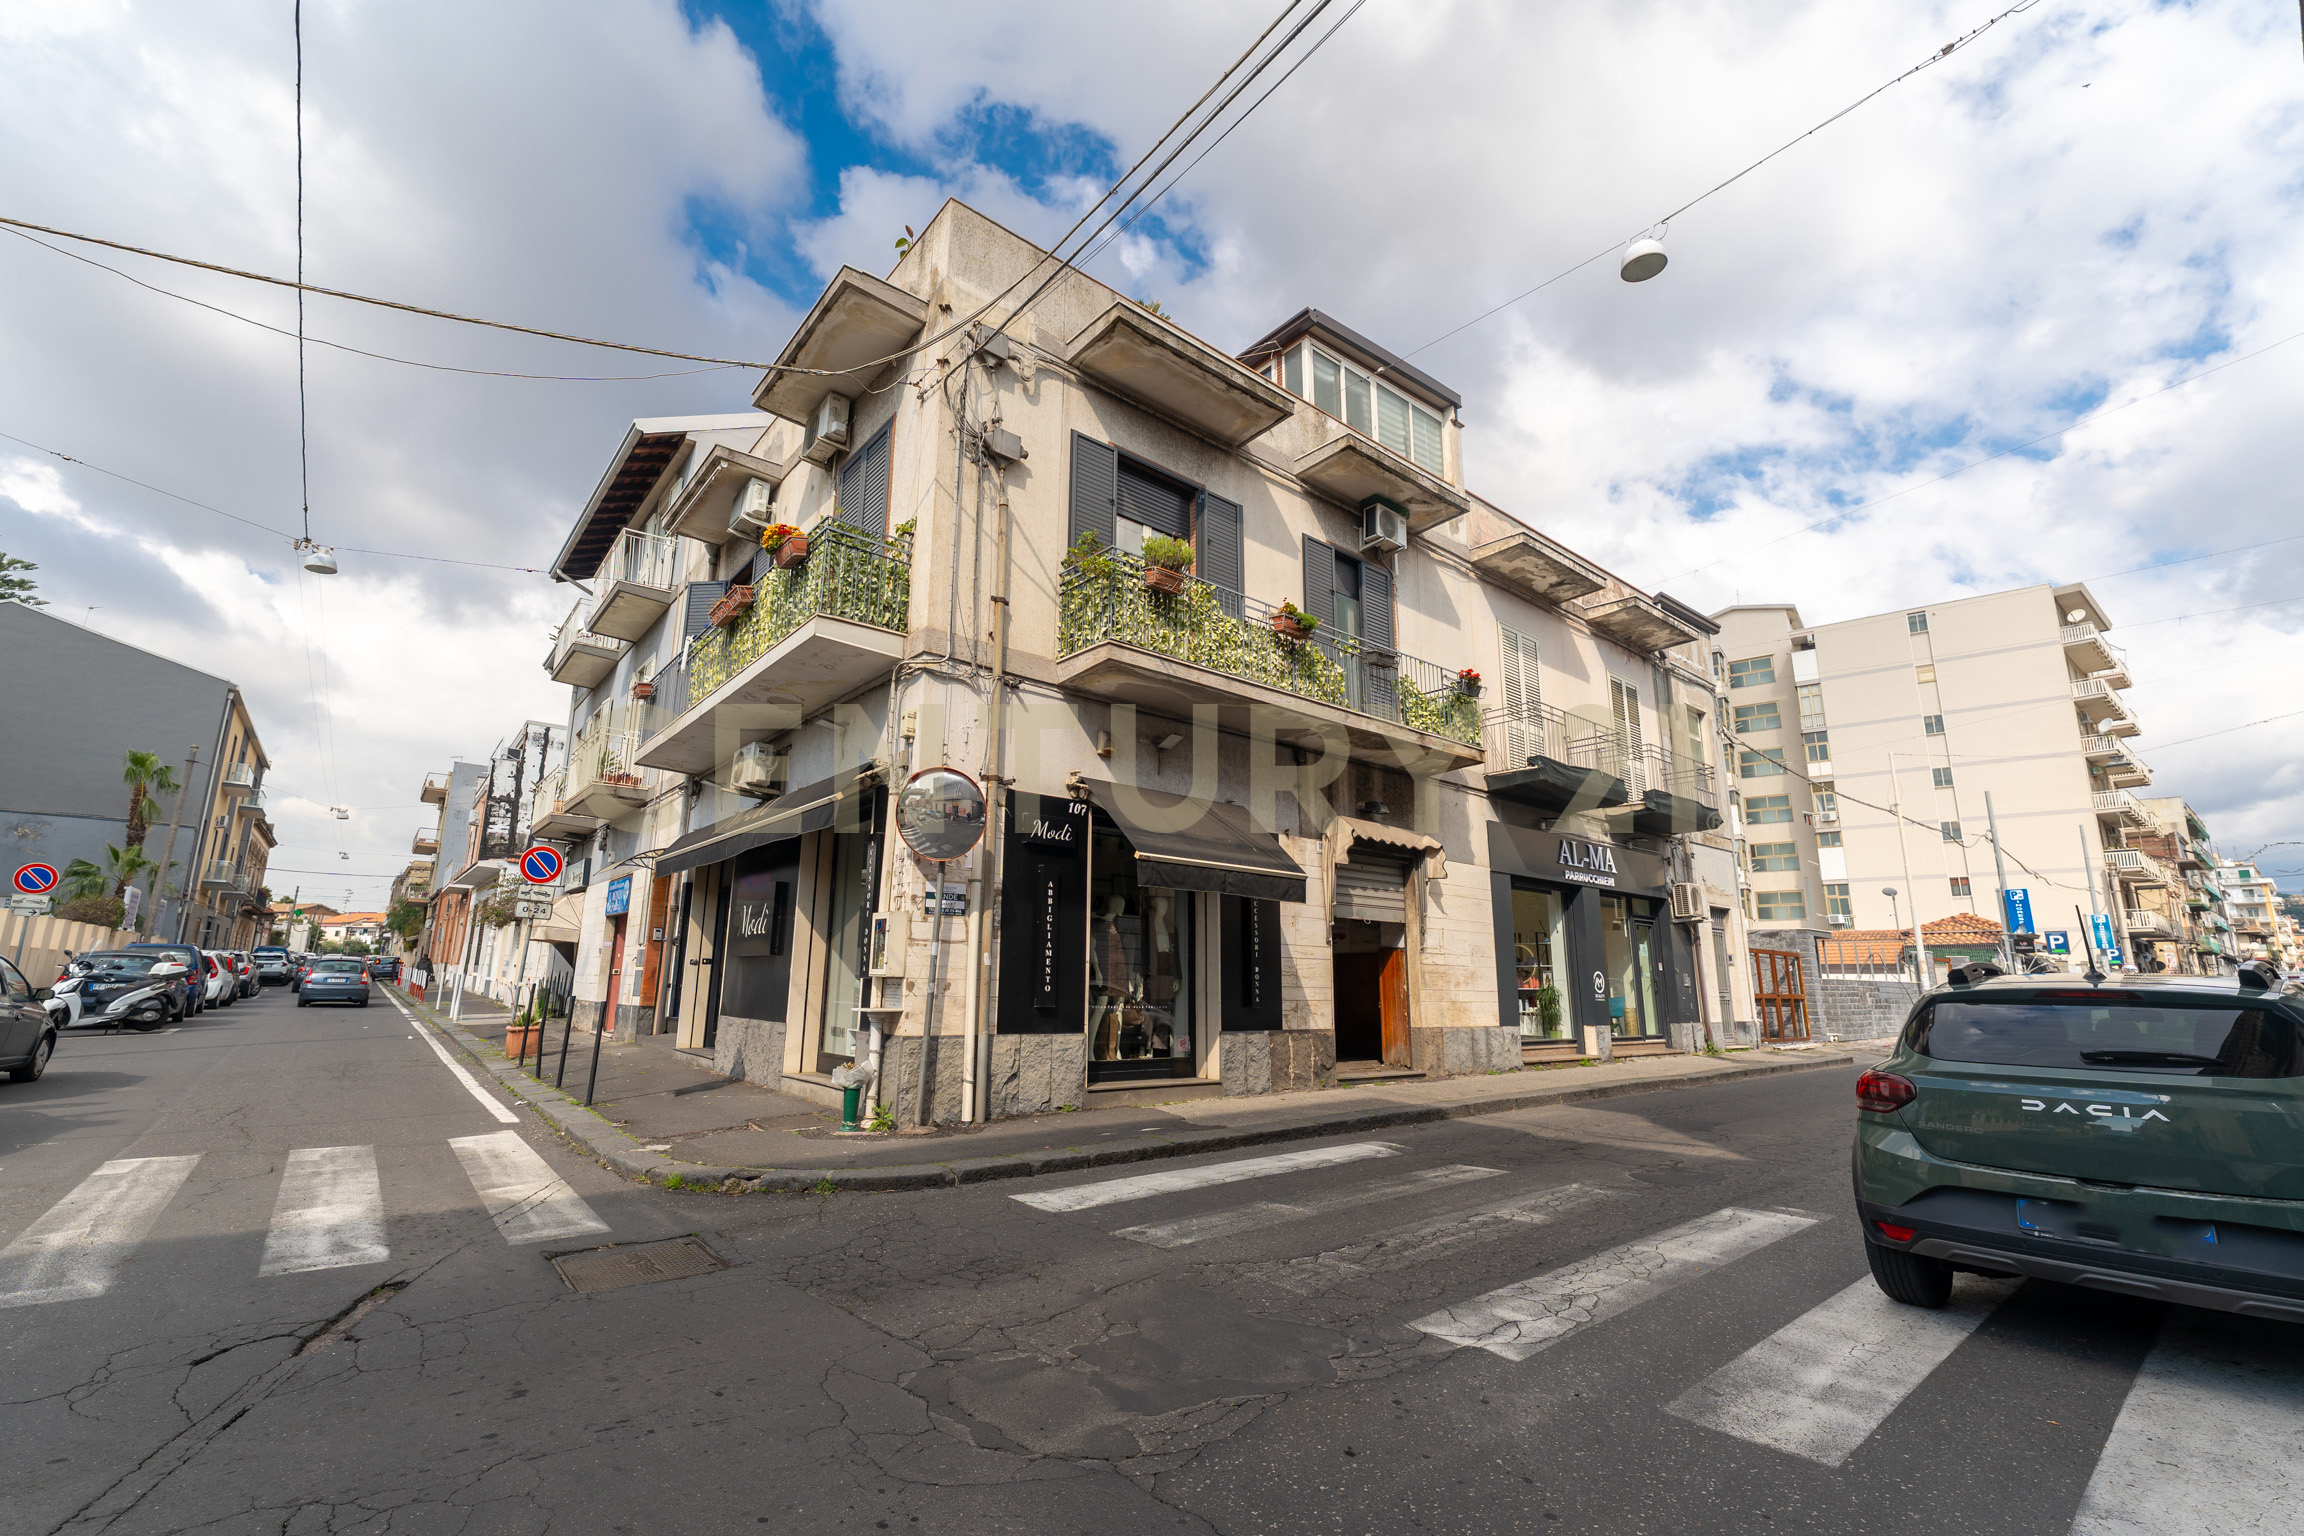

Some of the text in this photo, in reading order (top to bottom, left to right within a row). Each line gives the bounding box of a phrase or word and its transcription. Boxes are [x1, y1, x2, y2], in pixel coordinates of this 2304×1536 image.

[1068, 802, 1087, 817] 107
[1559, 839, 1618, 874] AL-MA
[1564, 870, 1615, 887] PARRUCCHIERI
[522, 906, 547, 915] 0-24
[1044, 881, 1054, 993] ABBIGLIAMENTO
[2049, 935, 2064, 949] P
[2106, 949, 2119, 961] P
[2021, 1098, 2171, 1122] DACIA
[1918, 1120, 1985, 1135] SANDERO
